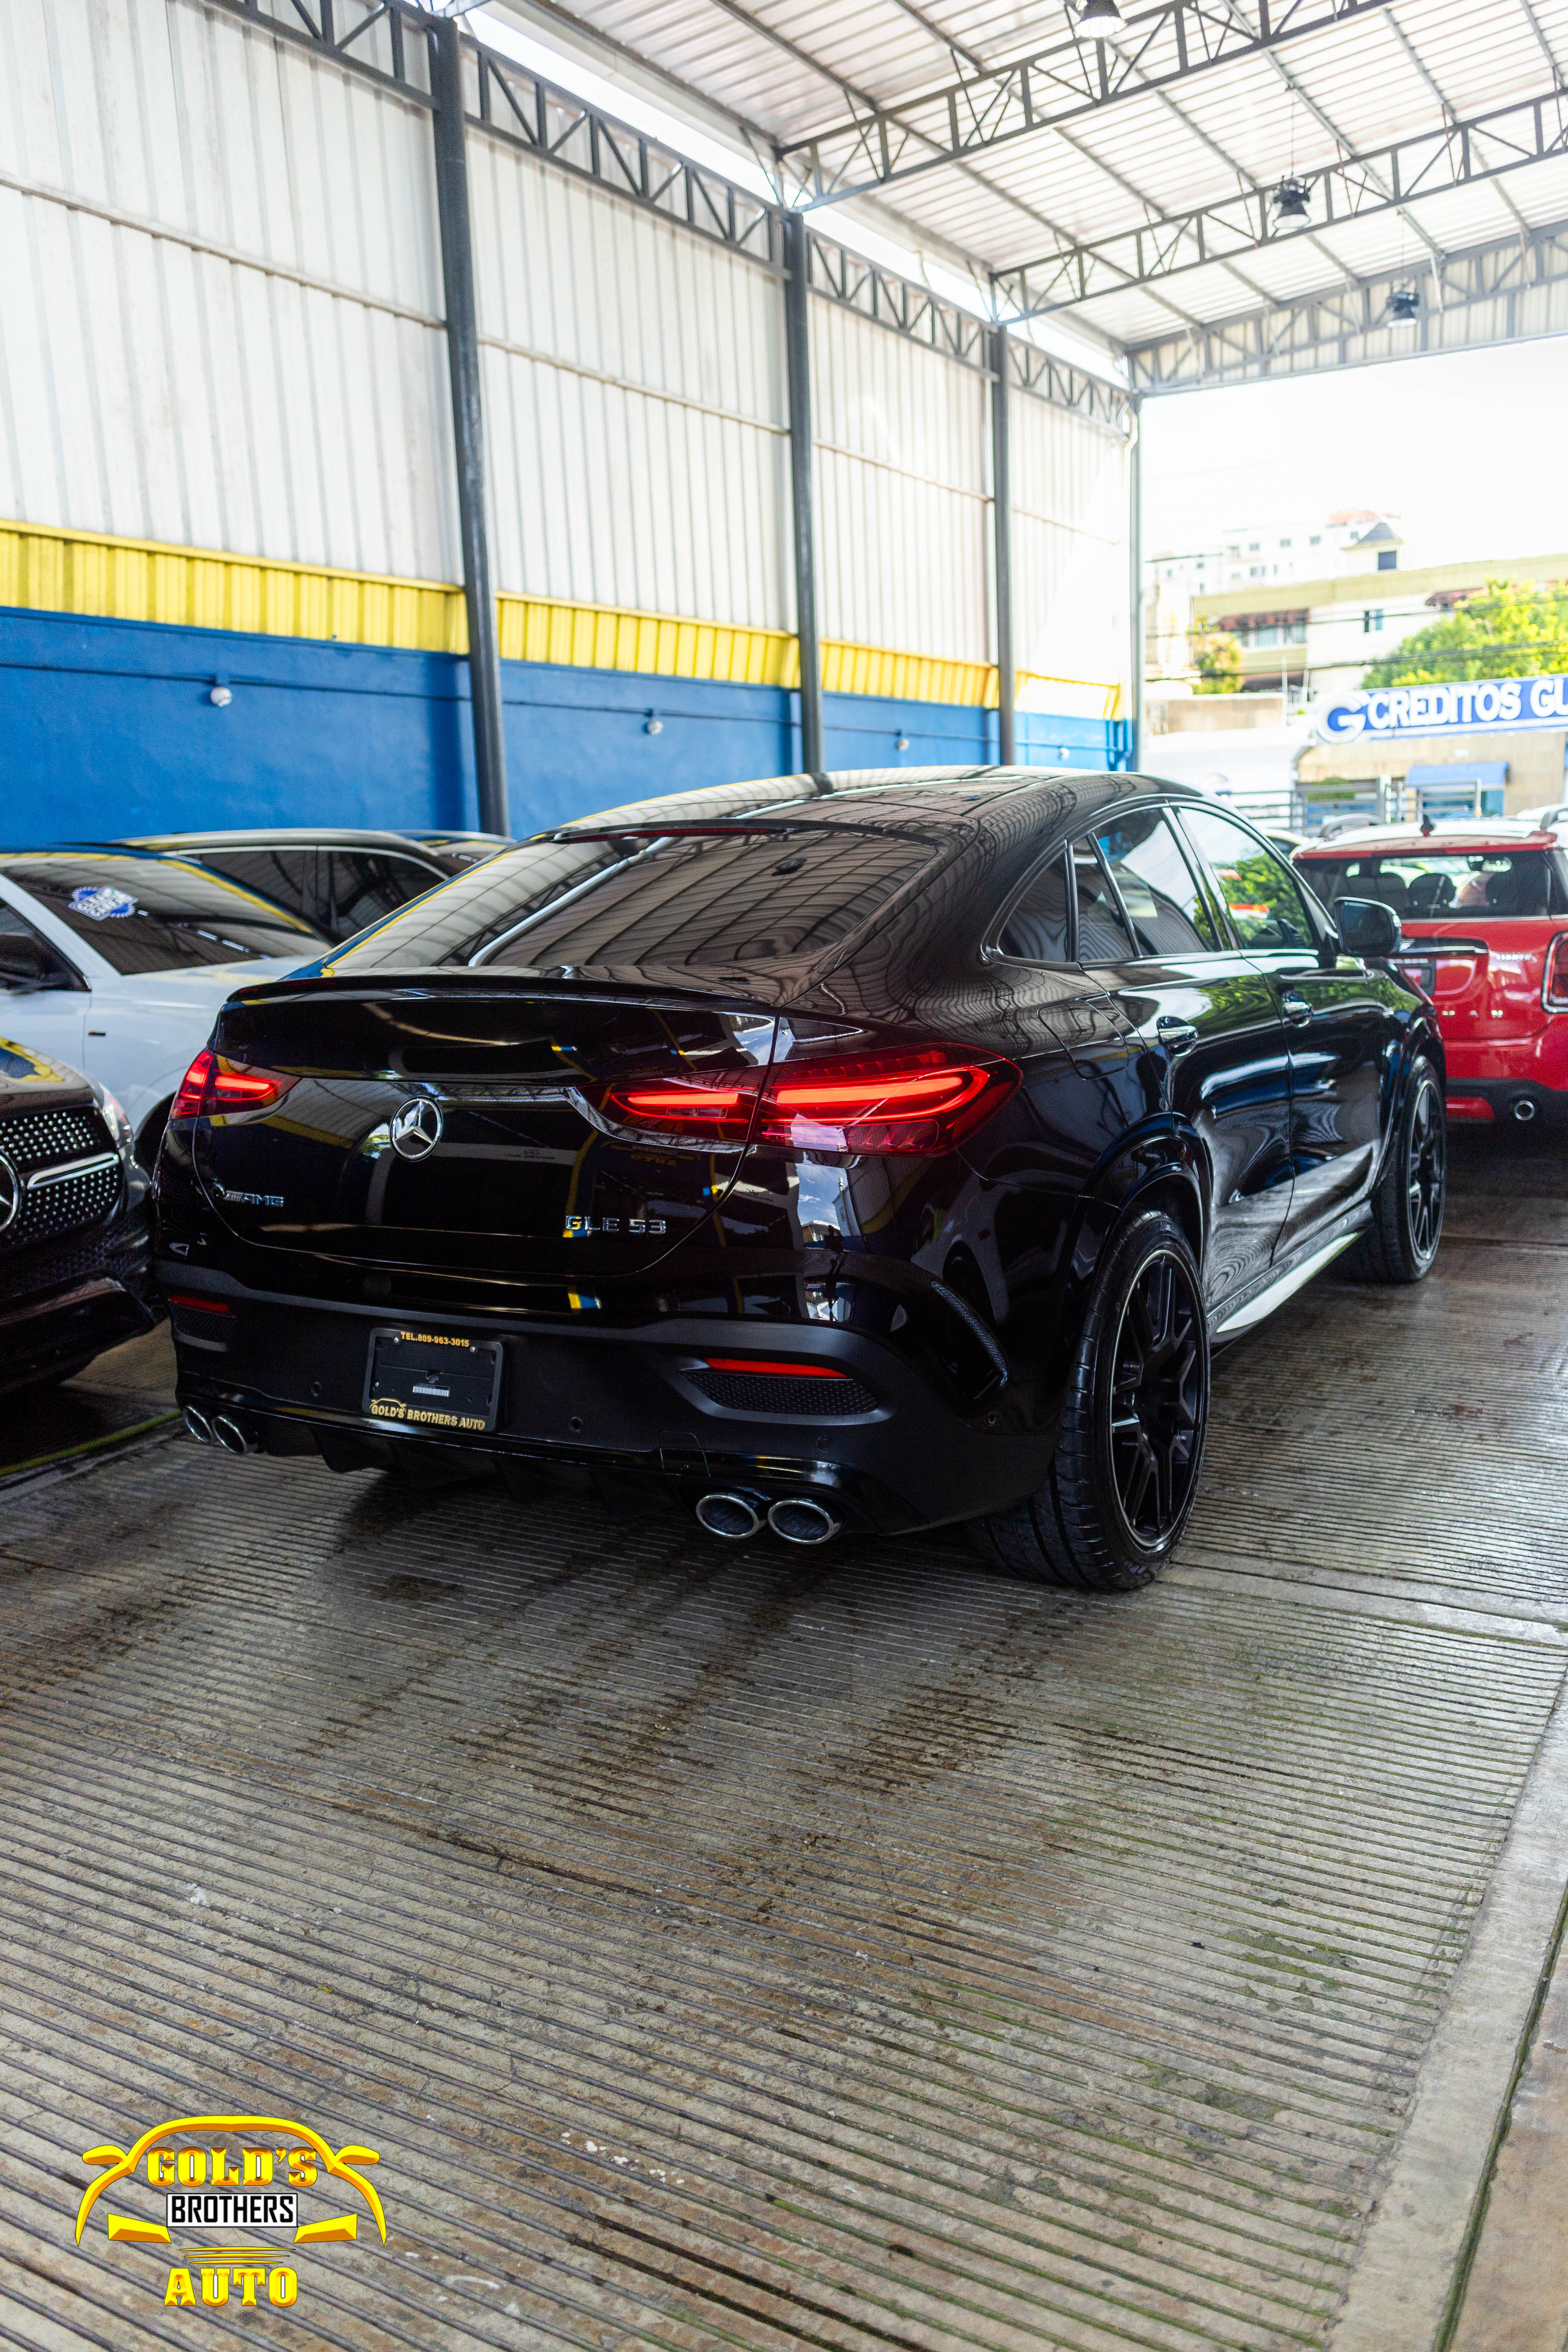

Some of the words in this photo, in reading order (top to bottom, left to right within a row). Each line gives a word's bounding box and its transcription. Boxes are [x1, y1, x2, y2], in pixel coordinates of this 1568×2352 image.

[1367, 682, 1521, 730] CREDITOS
[241, 1193, 283, 1207] AMG
[566, 1216, 619, 1231] GLE
[629, 1219, 666, 1234] 53
[371, 1404, 404, 1417] GOLD'S
[407, 1410, 457, 1426] BROTHERS
[459, 1417, 485, 1430] AUTO
